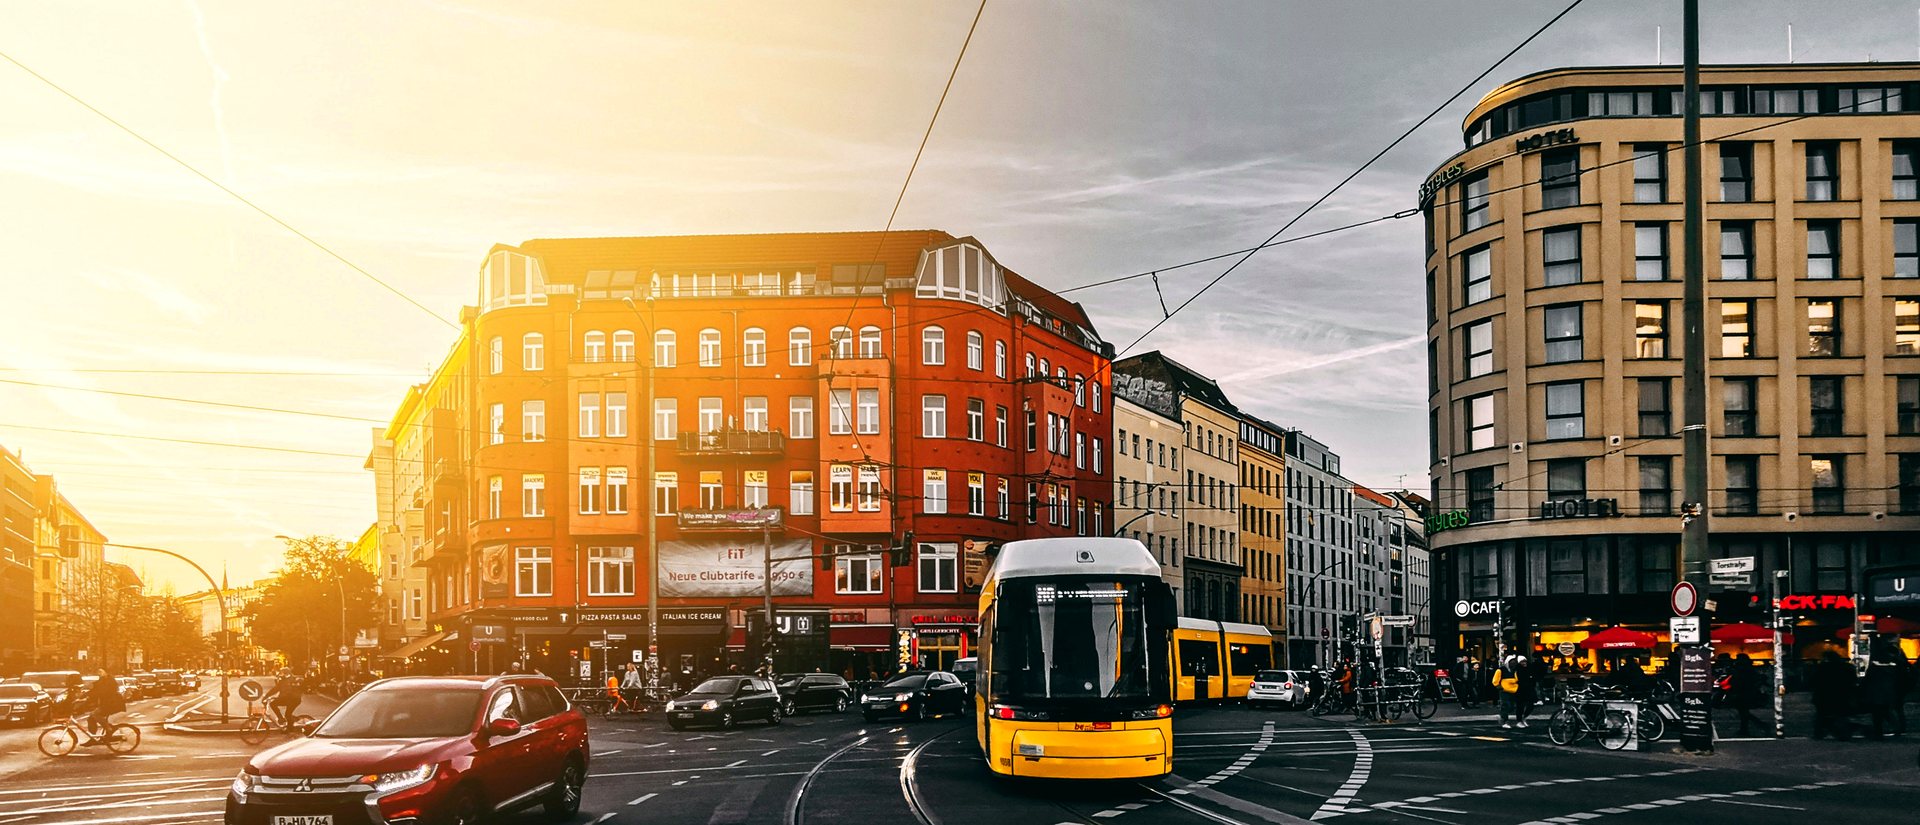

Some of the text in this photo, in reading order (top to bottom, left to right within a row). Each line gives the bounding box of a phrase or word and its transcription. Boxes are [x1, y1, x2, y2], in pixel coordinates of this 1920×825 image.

[1516, 128, 1579, 153] HOTEL
[1541, 498, 1624, 519] HOTEL
[1716, 560, 1747, 569] Torstraße
[668, 572, 697, 581] Neue
[700, 570, 755, 581] Clubtarife
[1894, 577, 1905, 592] U
[485, 626, 493, 635] U
